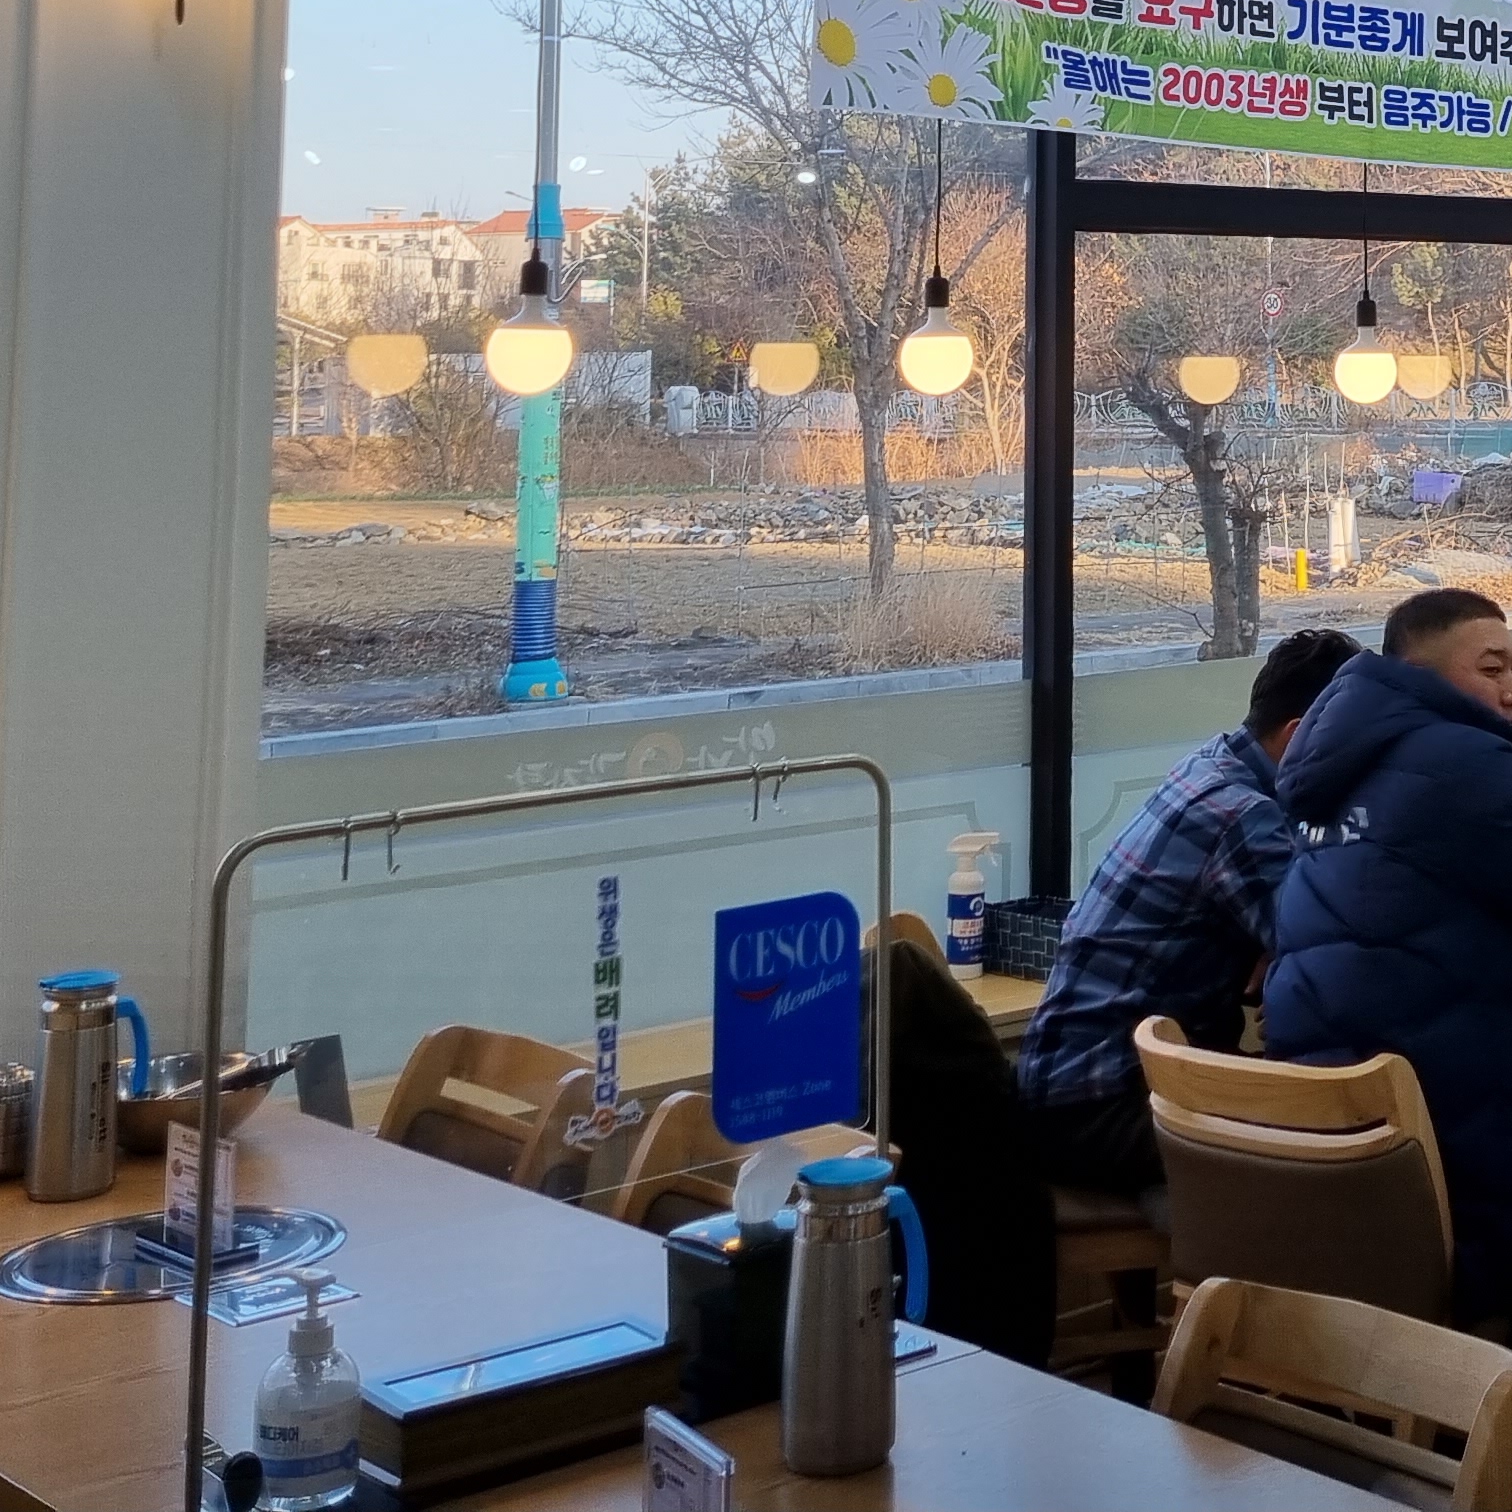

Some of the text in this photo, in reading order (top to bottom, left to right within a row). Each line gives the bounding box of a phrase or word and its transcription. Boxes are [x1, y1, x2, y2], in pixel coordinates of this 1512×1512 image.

[1045, 45, 1152, 101] "올해는
[1162, 67, 1309, 117] 2003년생
[1318, 81, 1375, 125] 부터
[1383, 88, 1492, 135] 음주가능
[728, 917, 845, 983] CESCO
[767, 969, 849, 1024] Members
